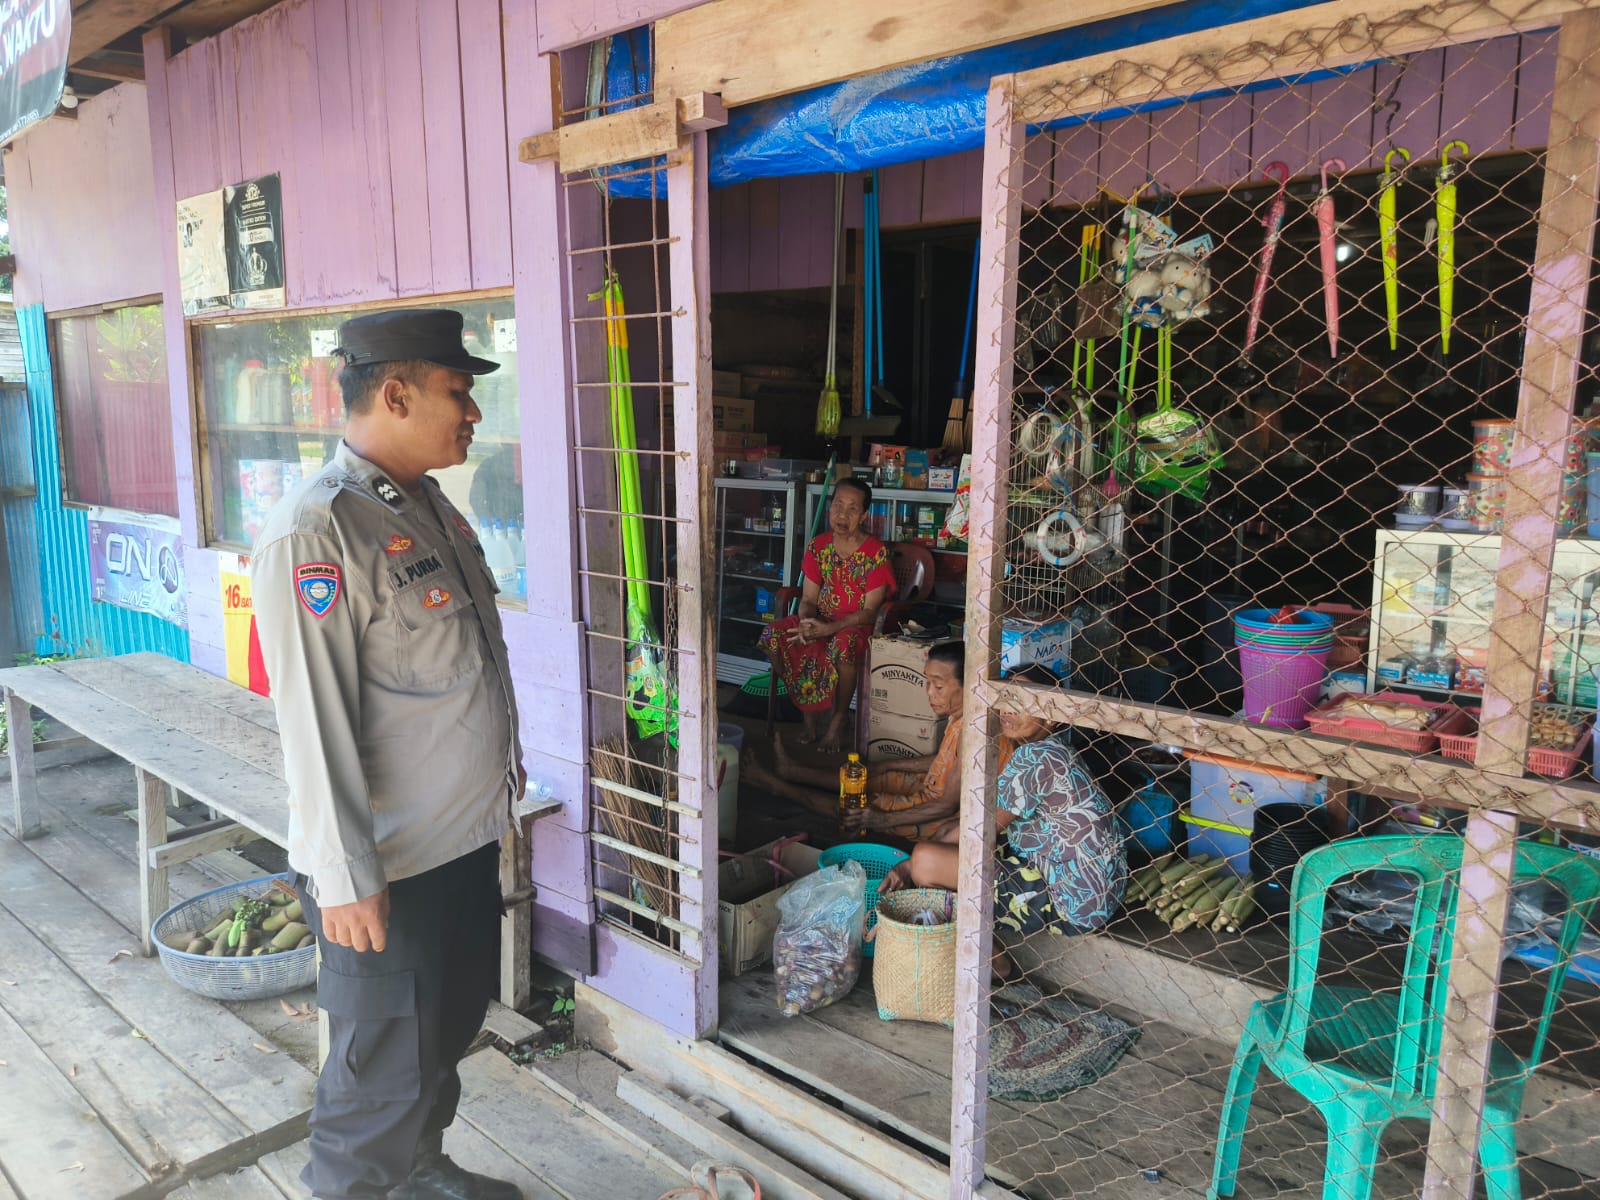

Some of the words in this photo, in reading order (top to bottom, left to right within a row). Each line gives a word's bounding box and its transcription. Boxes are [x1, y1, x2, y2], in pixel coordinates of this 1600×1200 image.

[3, 0, 56, 68] WAKTU
[105, 532, 152, 581] ON
[299, 566, 336, 576] BINMAS
[394, 571, 408, 588] J.
[405, 554, 443, 582] PURBA
[225, 584, 241, 609] 16
[881, 669, 924, 688] MINYAKITA
[878, 744, 915, 759] MINYAKIT
